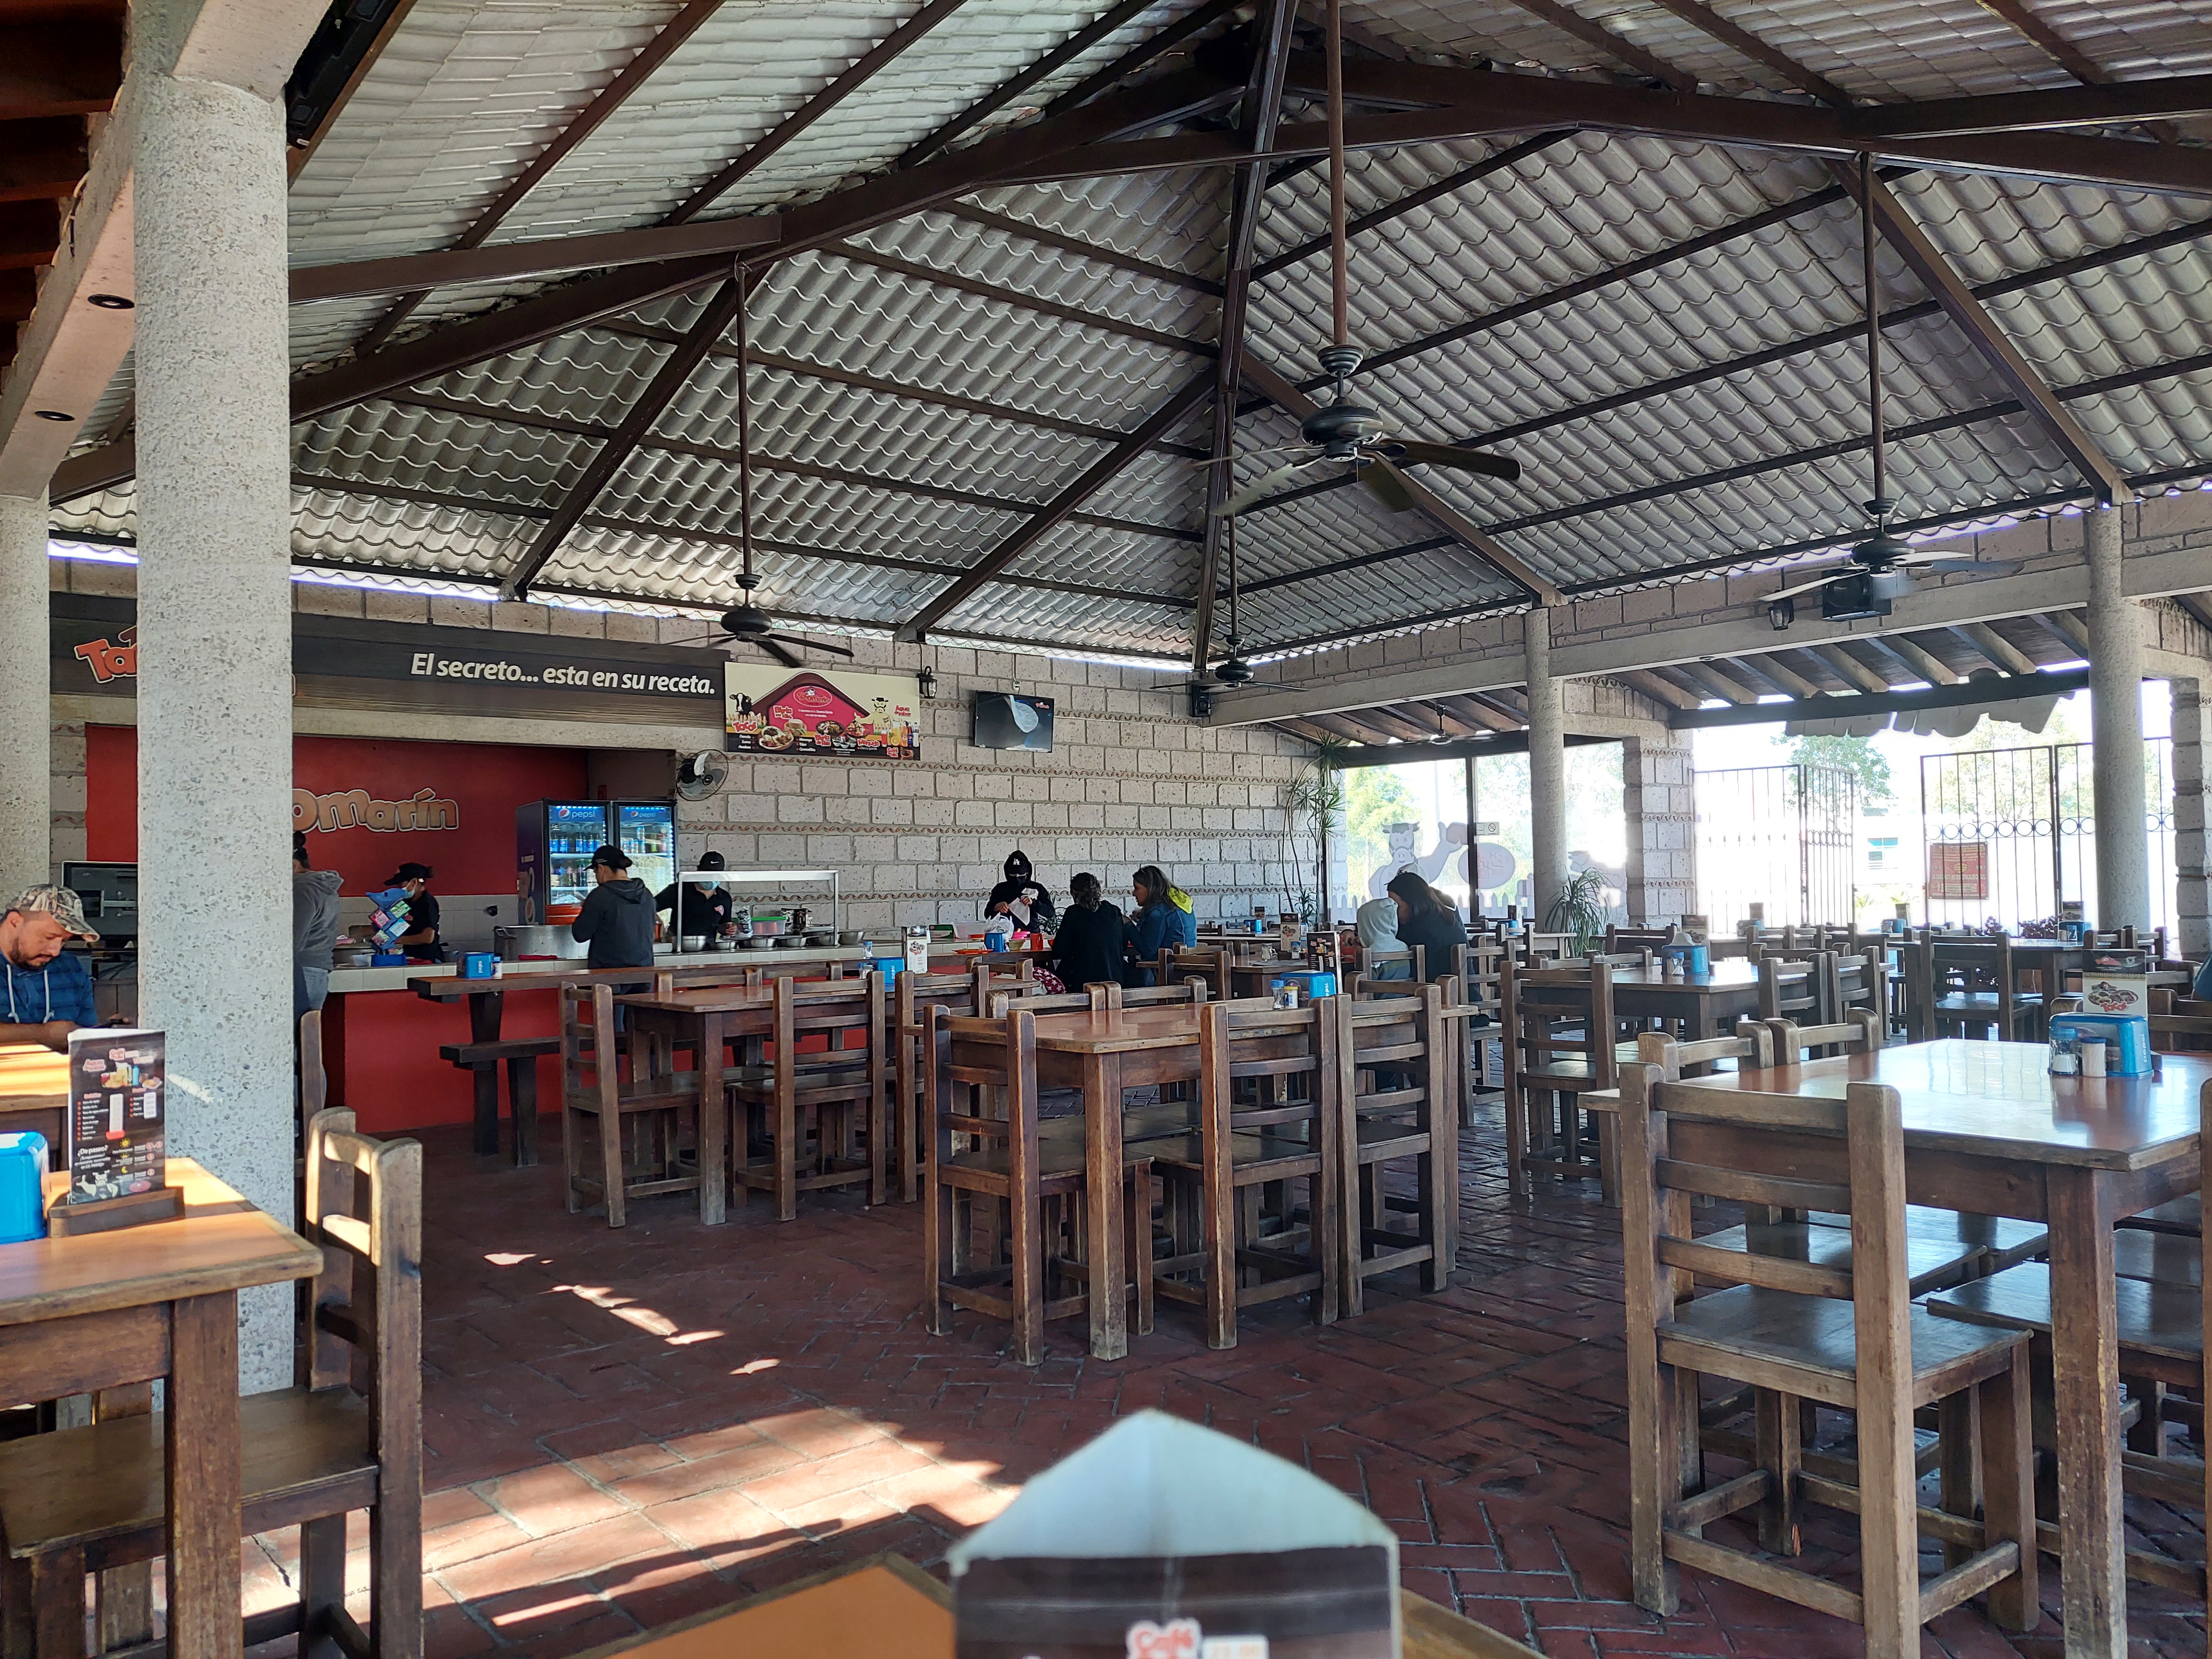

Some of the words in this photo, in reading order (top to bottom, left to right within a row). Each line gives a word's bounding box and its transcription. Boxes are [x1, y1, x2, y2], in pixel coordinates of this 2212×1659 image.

[411, 653, 435, 675] El
[436, 660, 539, 683] secreto...
[542, 666, 589, 686] esta
[592, 671, 619, 687] en
[621, 673, 646, 689] su
[648, 675, 715, 694] receta.
[571, 809, 596, 819] pepsi
